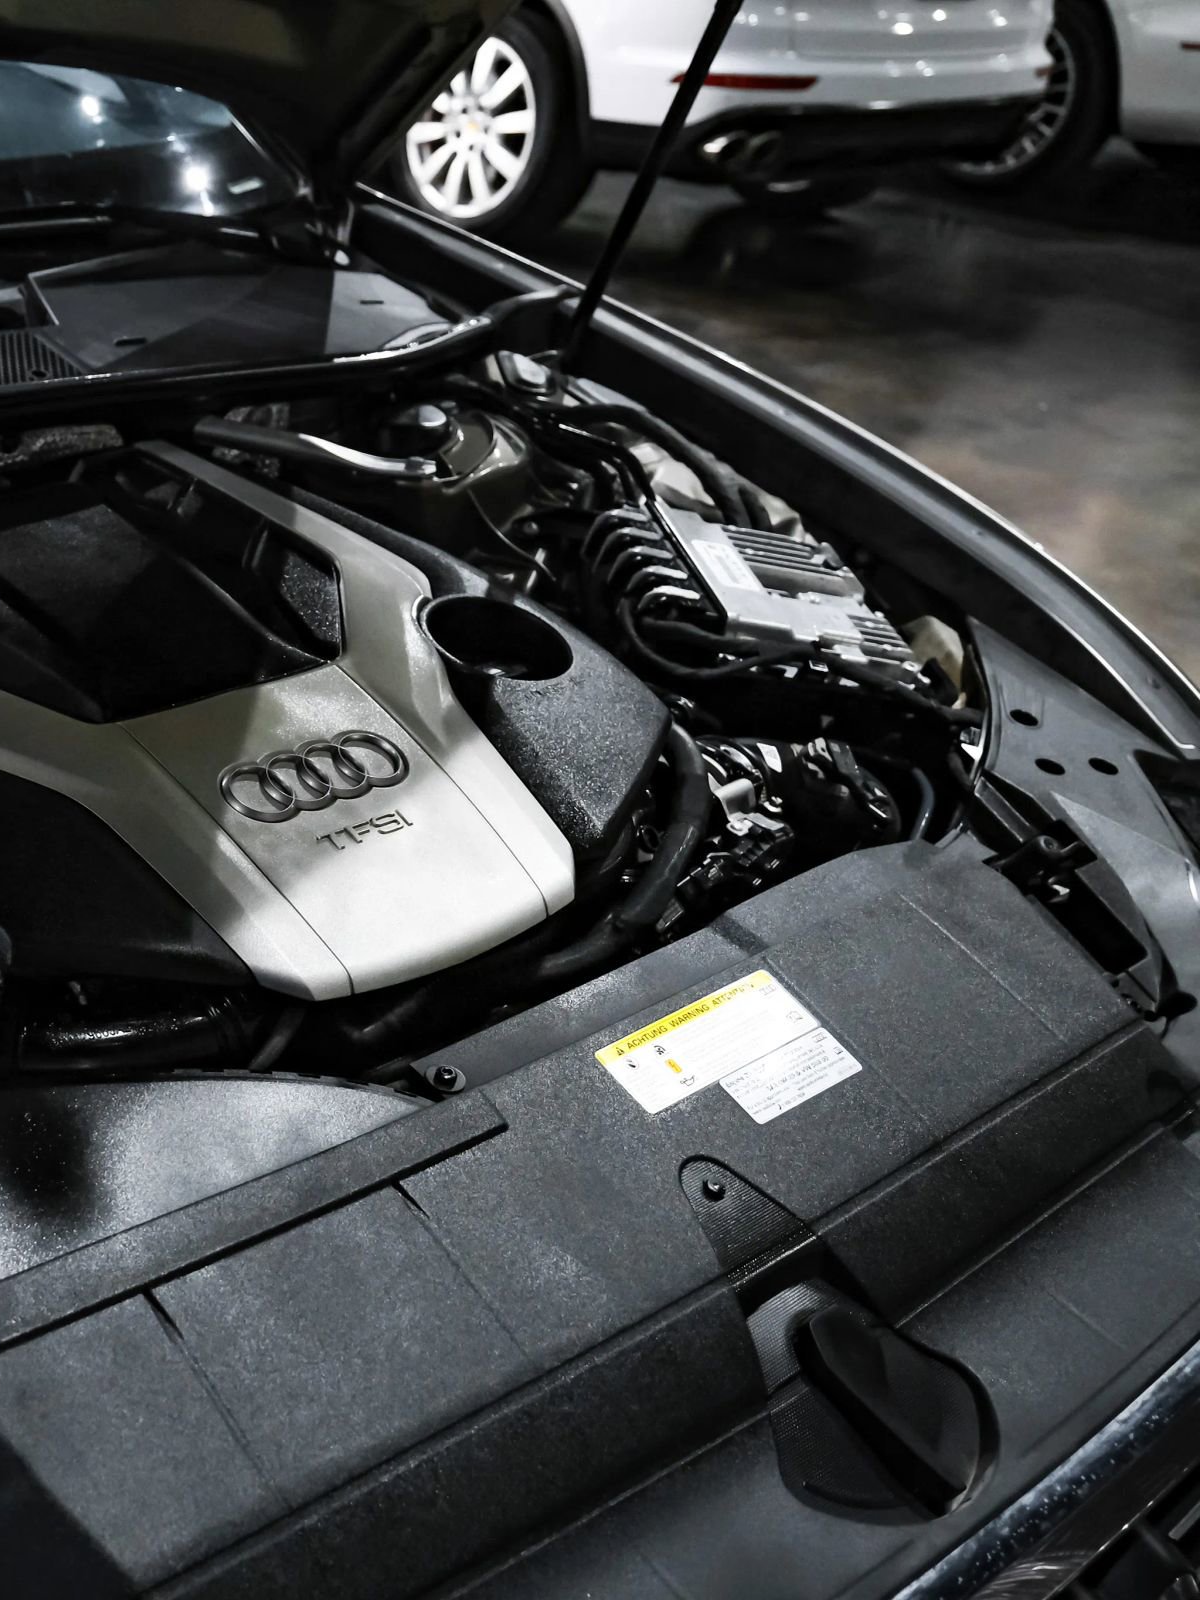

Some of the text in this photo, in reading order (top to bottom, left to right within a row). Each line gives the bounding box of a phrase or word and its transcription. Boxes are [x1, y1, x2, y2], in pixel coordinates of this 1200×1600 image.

[316, 808, 414, 851] TFSI
[627, 1025, 668, 1050] ACHTUNG
[669, 1003, 711, 1028] WARNING
